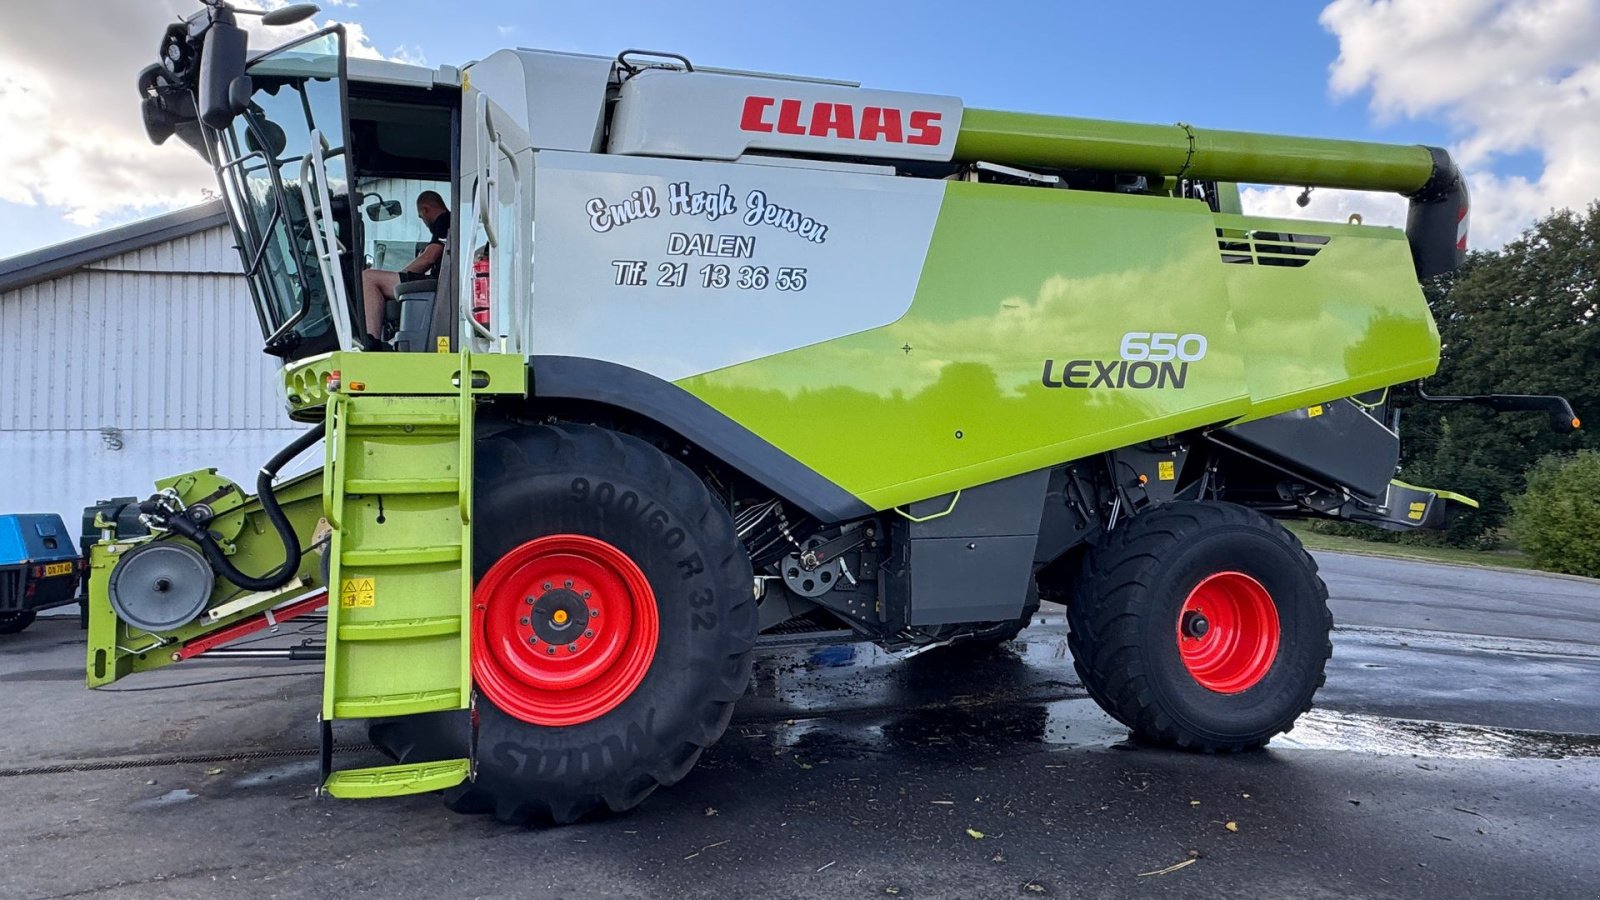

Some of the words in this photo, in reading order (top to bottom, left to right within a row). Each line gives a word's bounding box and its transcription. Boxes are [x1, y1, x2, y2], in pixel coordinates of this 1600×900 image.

[740, 96, 942, 145] CLAAS
[586, 186, 660, 232] Emil
[668, 181, 737, 221] Høgh
[743, 190, 828, 243] Jensen
[667, 232, 755, 258] DALEN
[612, 260, 647, 286] Tlf.
[656, 262, 688, 287] 21
[699, 264, 730, 288] 13
[737, 265, 769, 289] 36
[775, 267, 807, 291] 55
[1120, 332, 1208, 361] 650
[1042, 359, 1188, 389] LEXION
[571, 477, 686, 549] 900/60
[677, 552, 704, 580] R
[689, 588, 718, 631] 32
